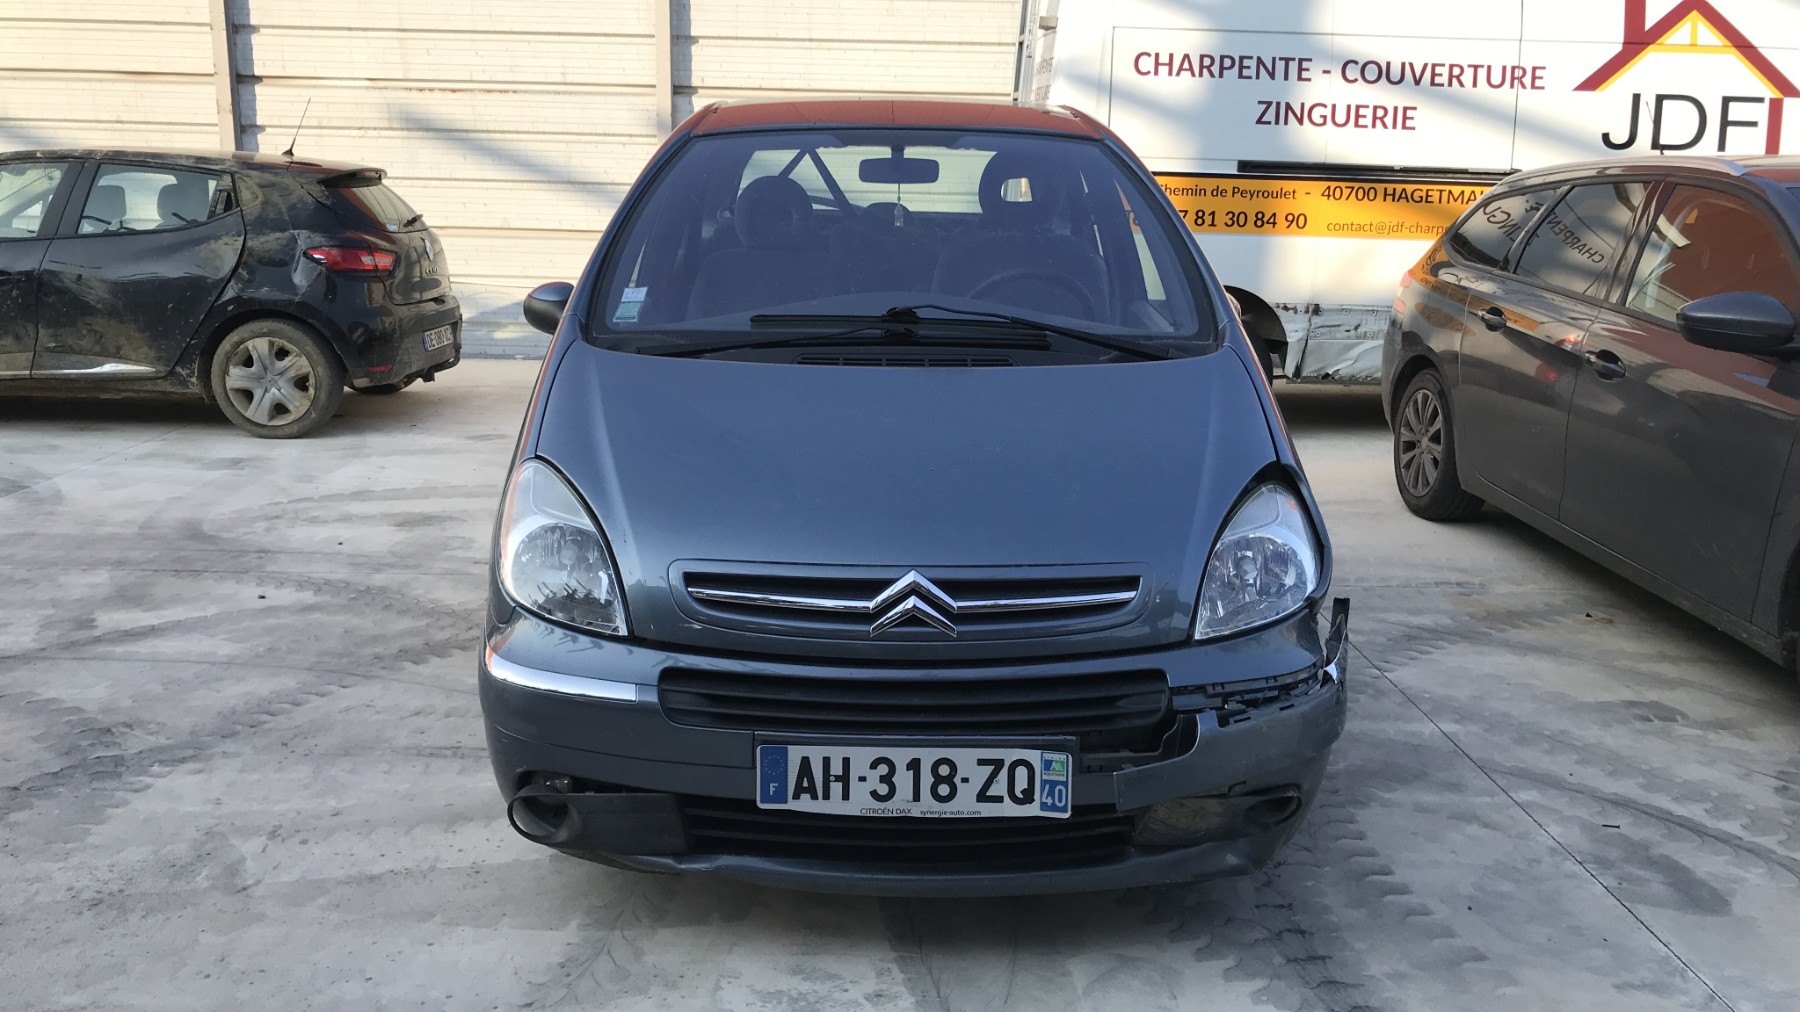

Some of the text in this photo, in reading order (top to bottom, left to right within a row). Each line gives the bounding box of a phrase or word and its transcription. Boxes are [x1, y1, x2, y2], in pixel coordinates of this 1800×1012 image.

[1133, 51, 1313, 82] CHARPENTE
[1340, 59, 1547, 90] COUVERTURE
[1255, 100, 1418, 131] ZINGUERIE
[1601, 92, 1766, 153] JDF
[1160, 183, 1207, 197] hemin
[1210, 185, 1228, 198] de
[1231, 186, 1297, 201] Peyroulet
[1320, 185, 1378, 201] 40700
[1383, 187, 1483, 205] HAGETMA
[1193, 209, 1218, 228] 81
[1224, 210, 1248, 228] 30
[1253, 211, 1278, 229] 84
[1284, 213, 1308, 230] 90
[769, 782, 779, 796] F
[792, 756, 1036, 806] AH-318-ZQ
[1041, 783, 1066, 808] 40
[895, 808, 912, 816] DAX
[919, 809, 982, 818] synergie-auto.com
